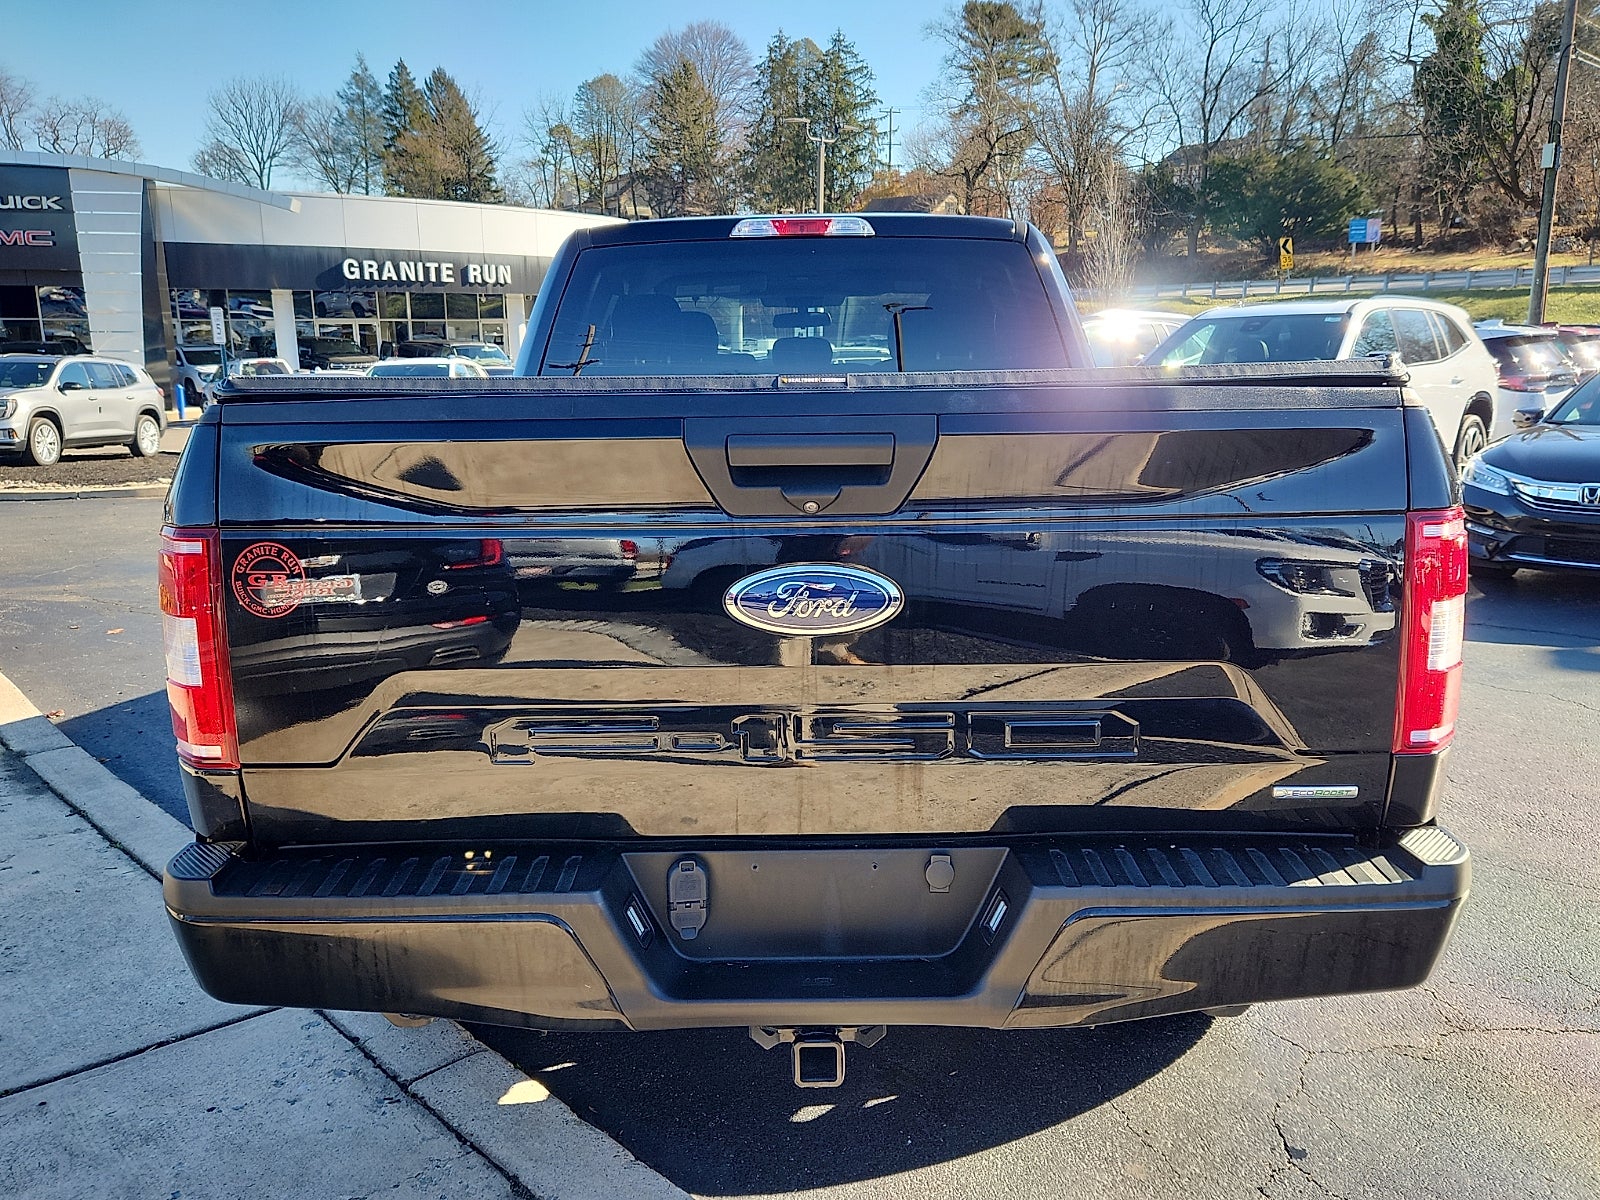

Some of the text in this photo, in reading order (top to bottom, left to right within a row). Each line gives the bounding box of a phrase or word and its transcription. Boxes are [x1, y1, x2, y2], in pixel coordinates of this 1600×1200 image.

[342, 257, 512, 285] GRANITE RUN
[236, 546, 300, 574] GRANITE RUN
[247, 574, 288, 586] GR
[767, 581, 859, 619] Ford
[490, 711, 1140, 765] F-150
